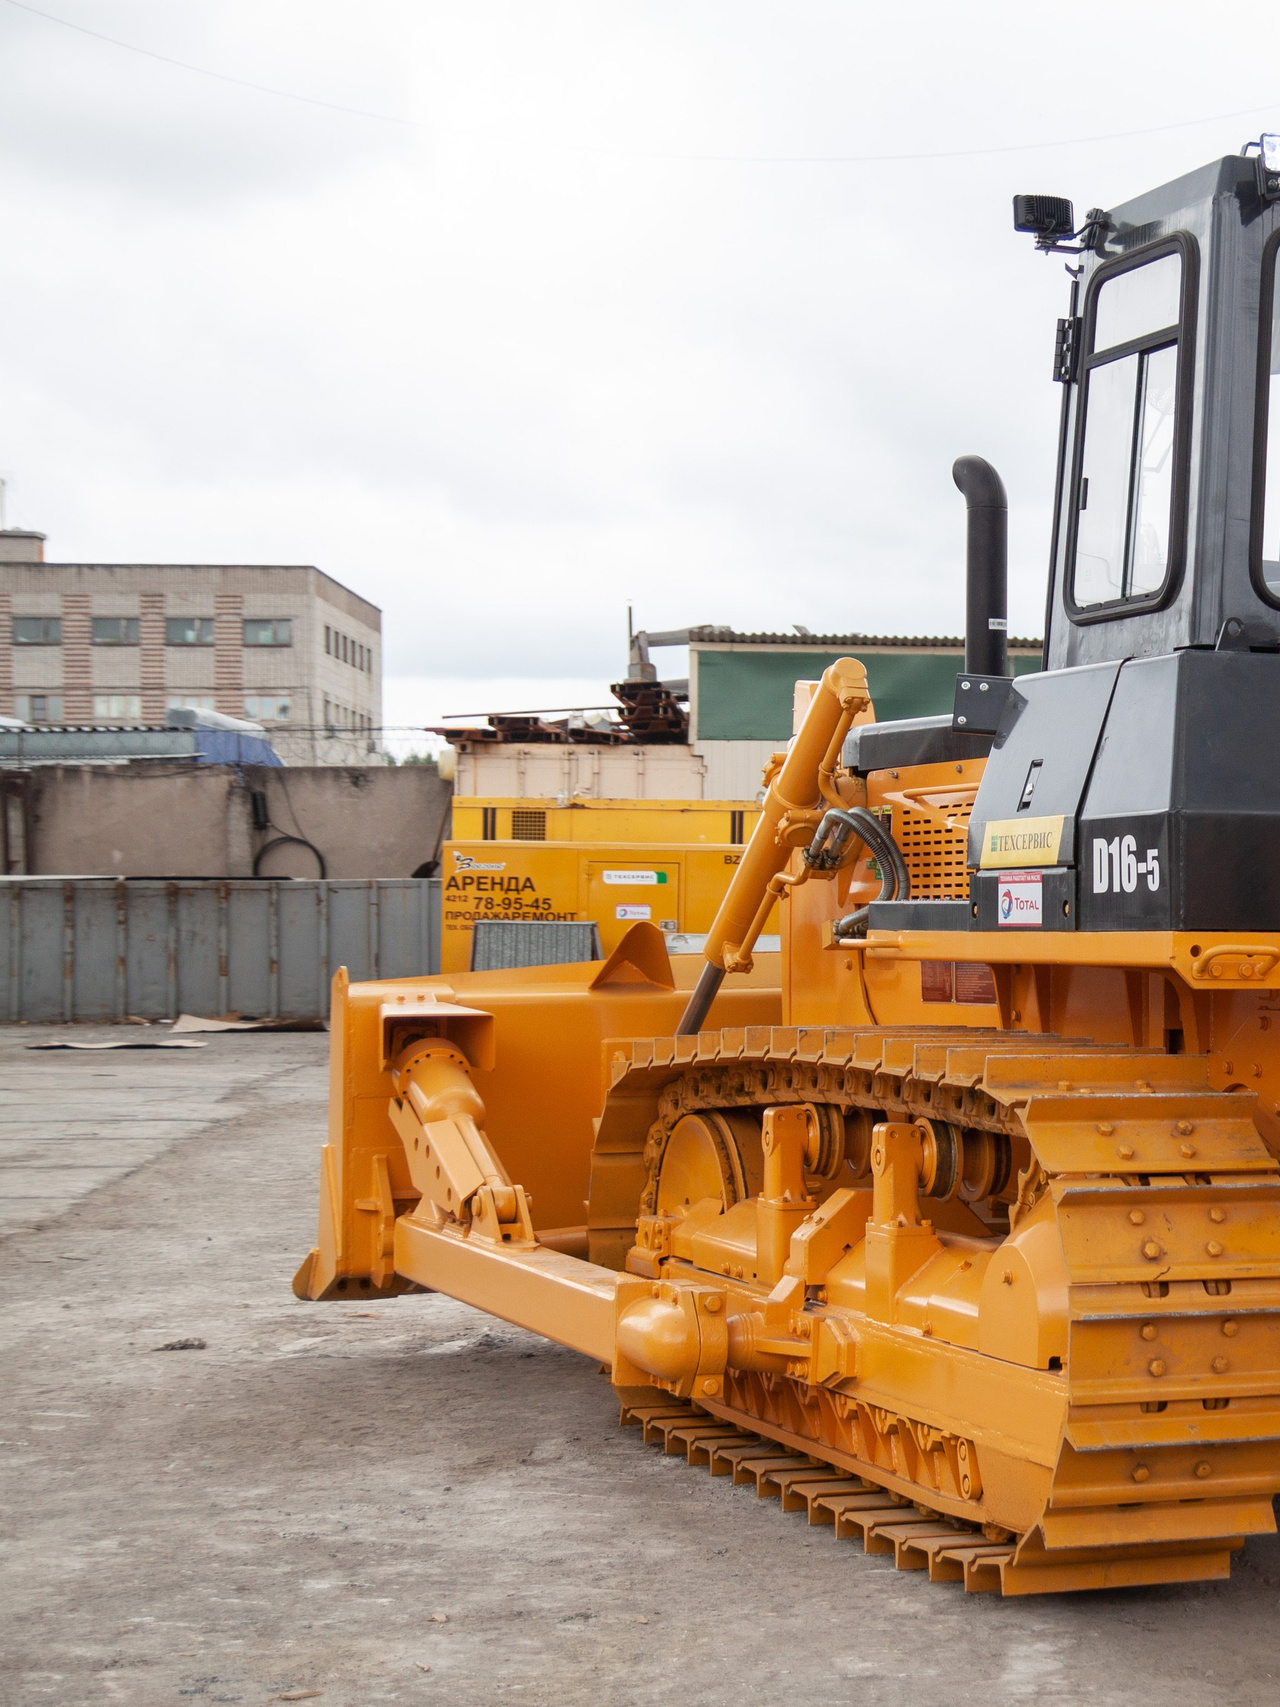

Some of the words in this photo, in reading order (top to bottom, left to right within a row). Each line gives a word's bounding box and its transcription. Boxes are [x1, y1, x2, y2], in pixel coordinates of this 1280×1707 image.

[998, 831, 1053, 852] ТЕХСЕРВИС
[1092, 834, 1160, 894] D16-5
[445, 875, 536, 895] АРЕНДА
[445, 895, 469, 903] 4212
[473, 896, 552, 911] 78-95-45
